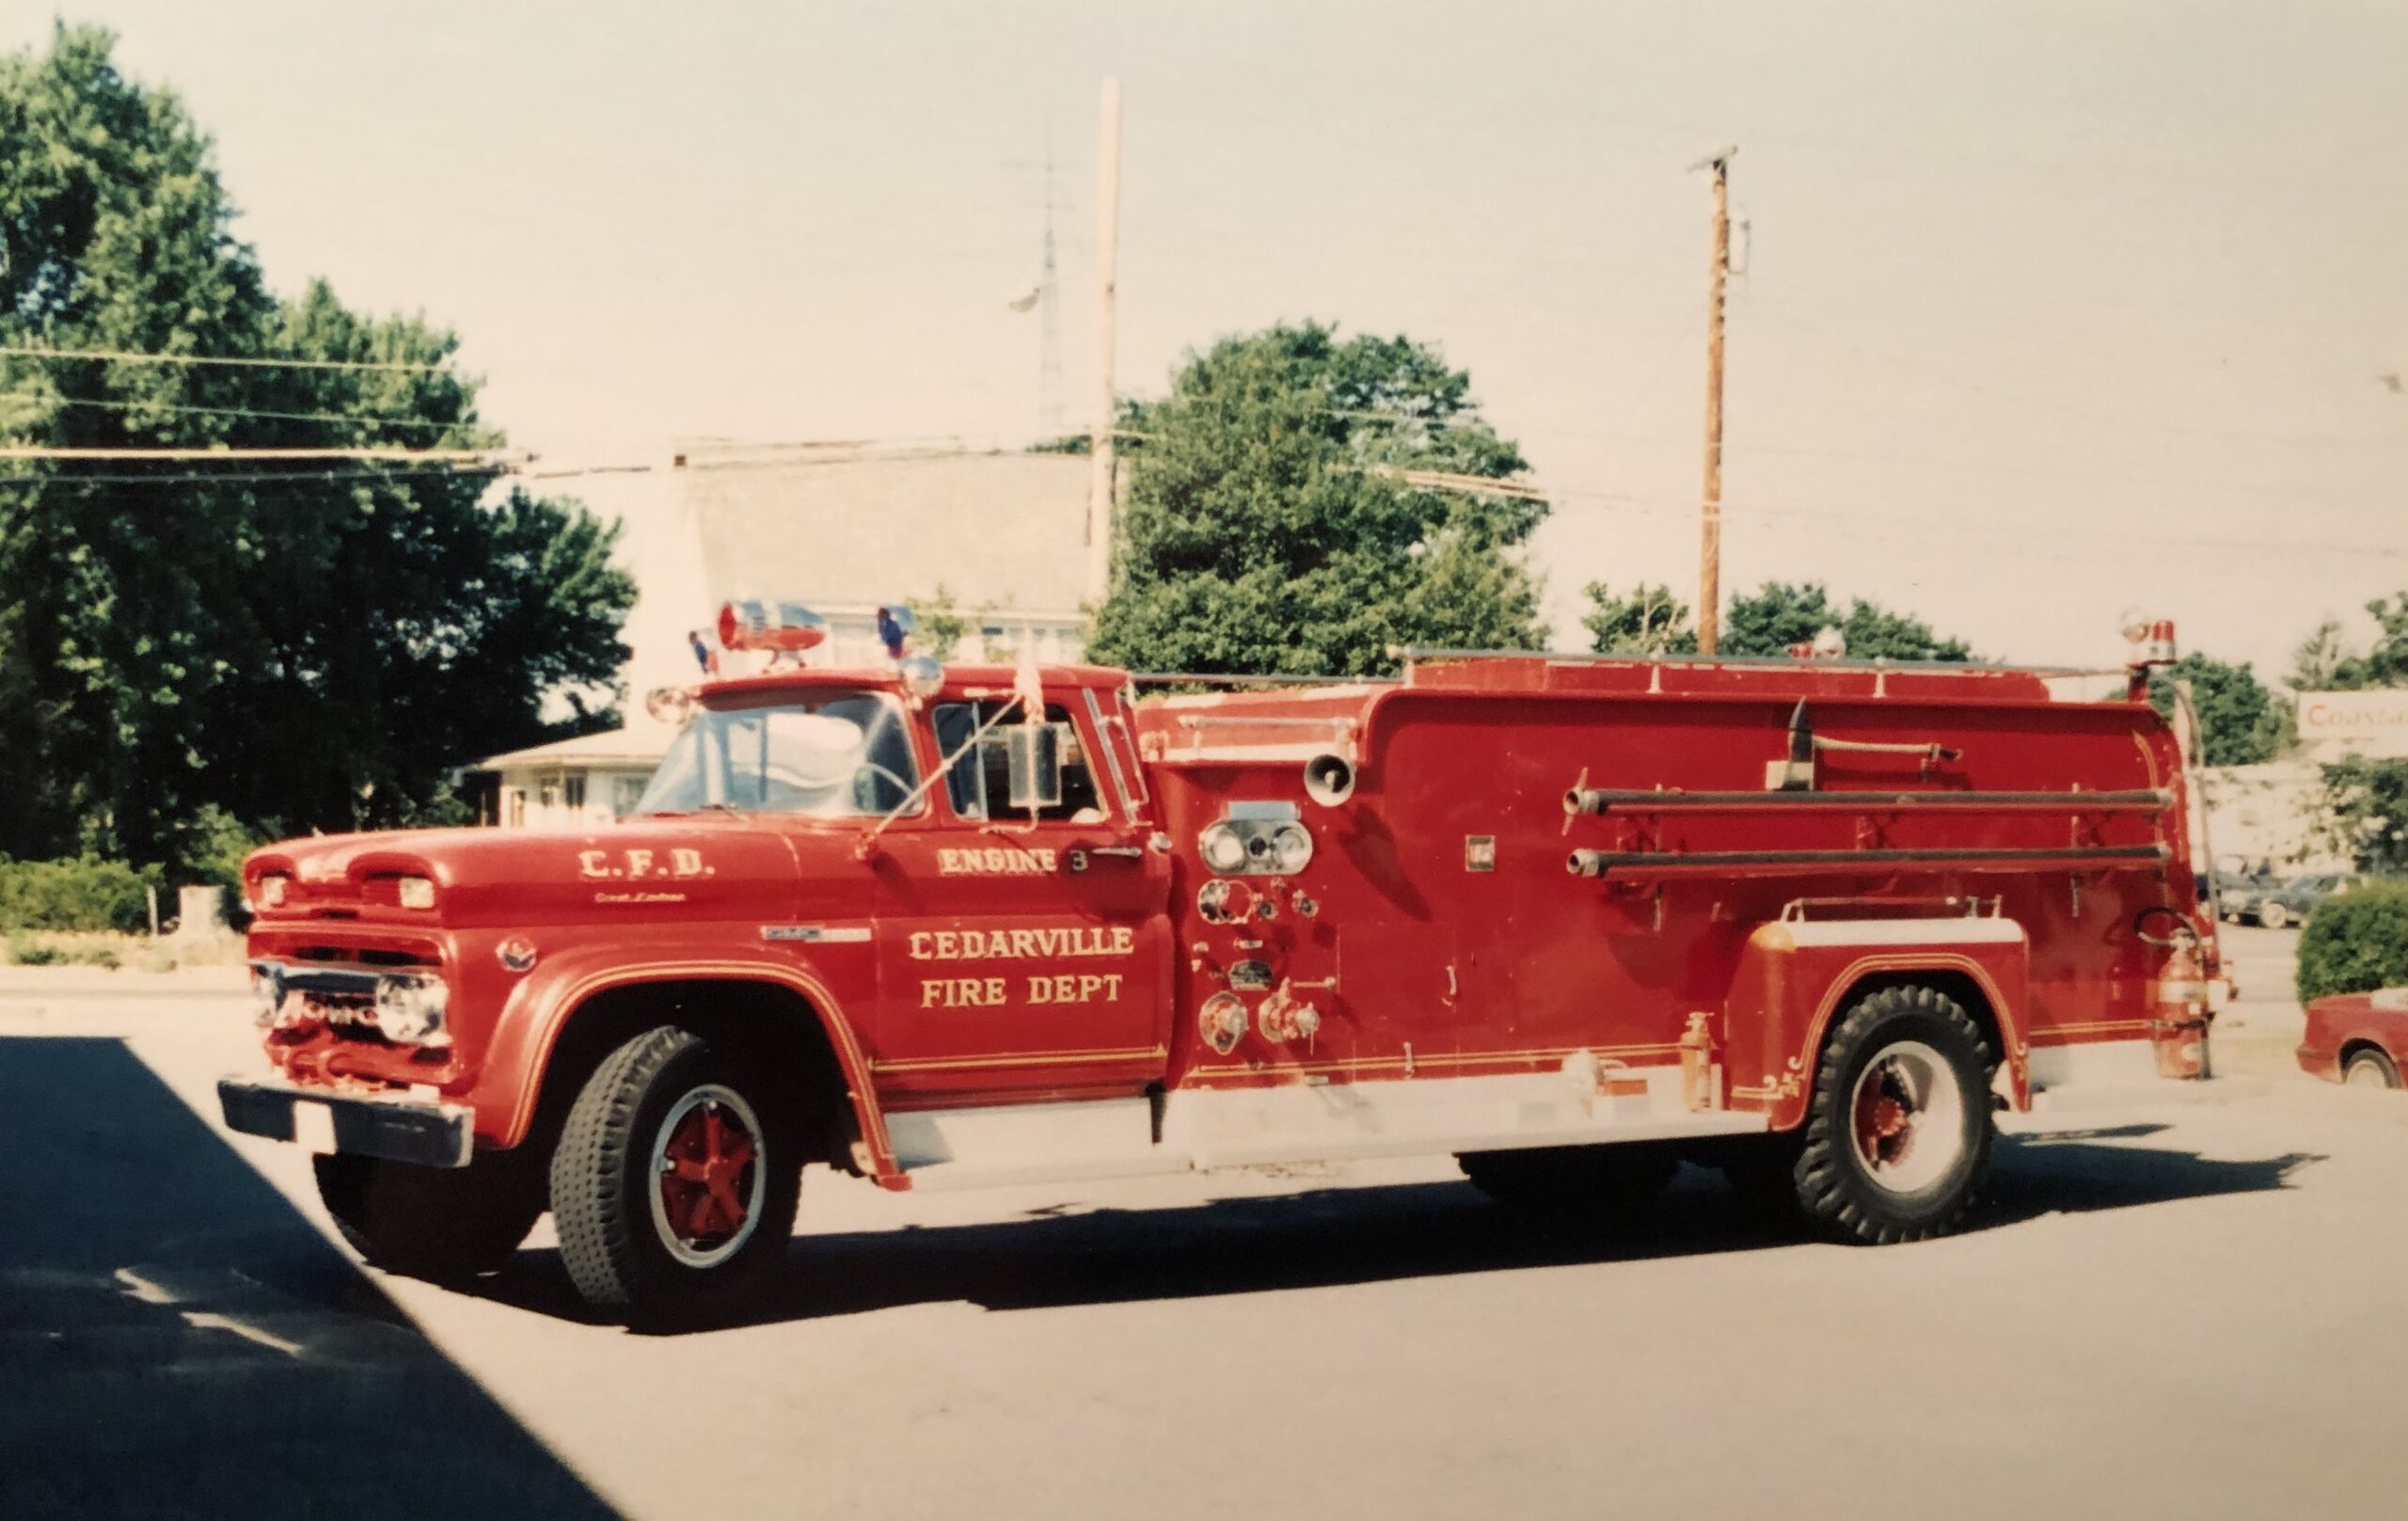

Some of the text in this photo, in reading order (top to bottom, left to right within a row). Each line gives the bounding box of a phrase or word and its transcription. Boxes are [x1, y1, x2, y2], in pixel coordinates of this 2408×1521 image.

[578, 848, 716, 879] C.F.D.
[939, 848, 1088, 875] ENGINE 3
[910, 927, 1134, 959] CEDARVILLE
[921, 974, 1123, 1008] FIRE DEPT
